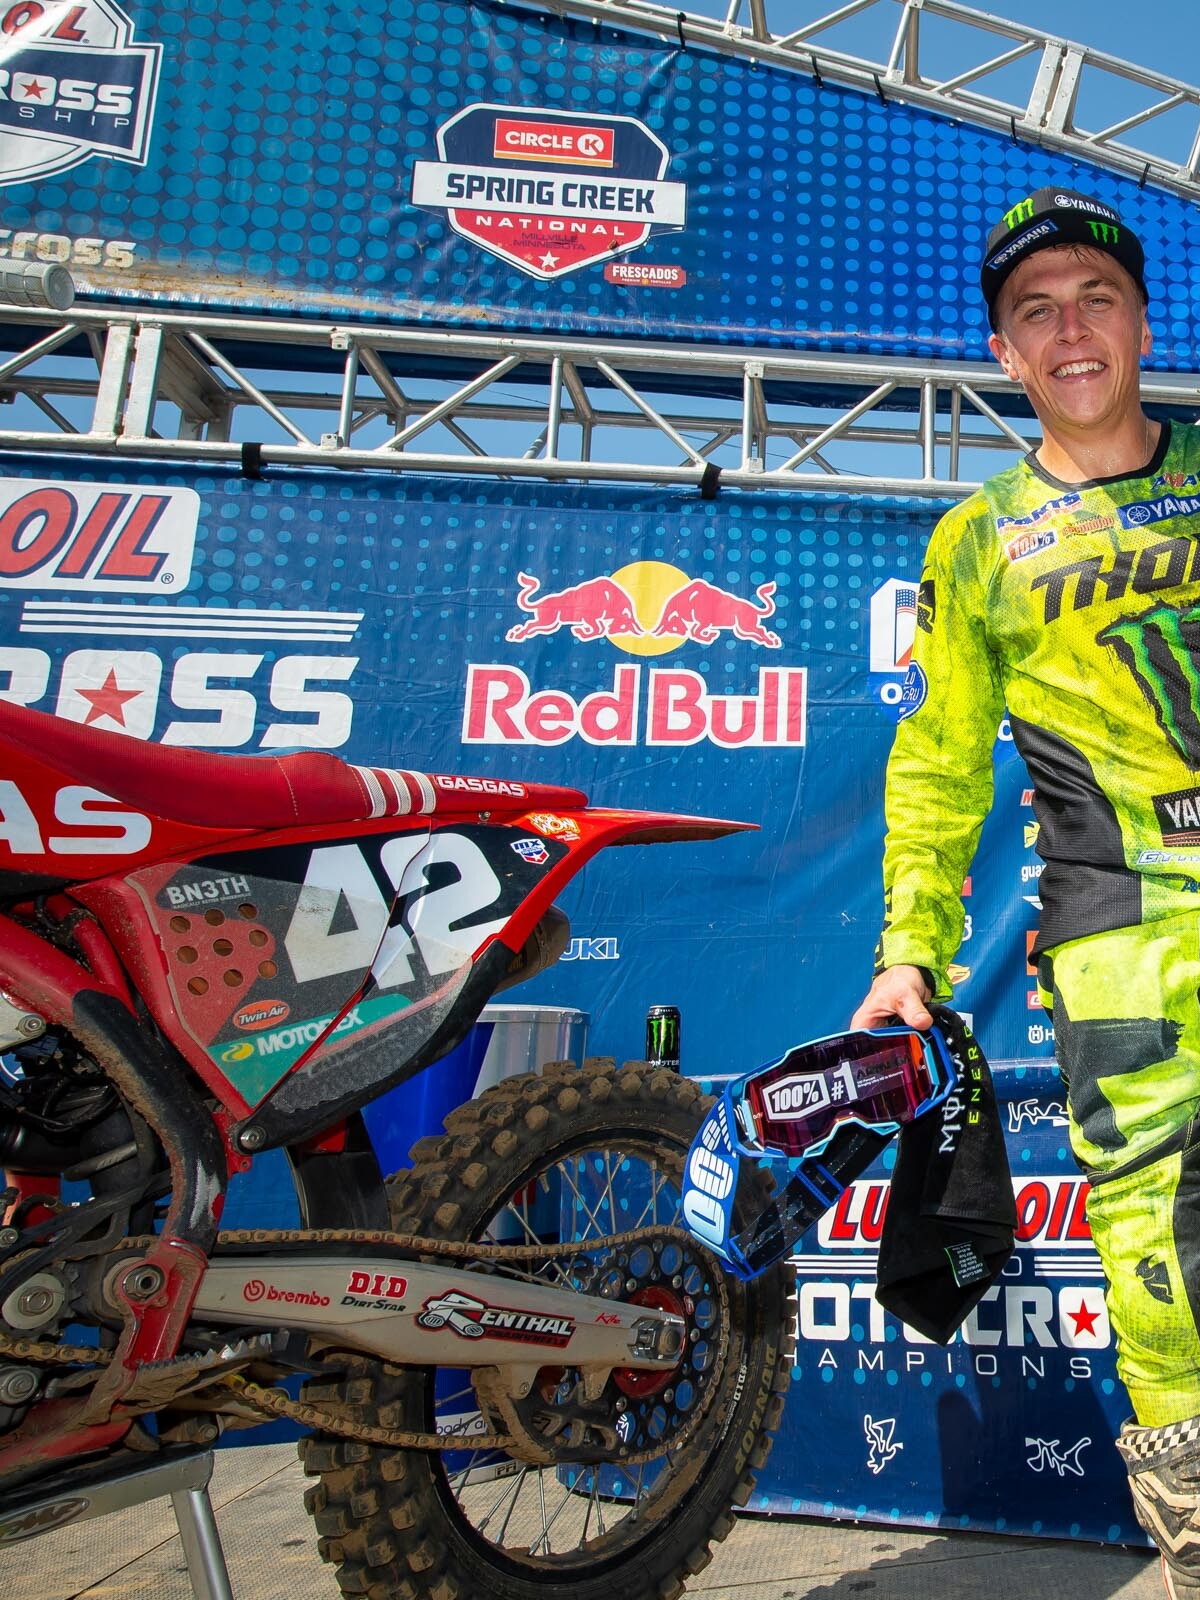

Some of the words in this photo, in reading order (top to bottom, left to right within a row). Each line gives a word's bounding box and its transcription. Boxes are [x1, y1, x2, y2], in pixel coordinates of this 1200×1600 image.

[1, 1, 88, 42] OL
[0, 69, 135, 115] OSS
[505, 130, 573, 150] CIRCLE
[578, 134, 604, 155] K
[446, 173, 555, 207] SPRING
[562, 182, 655, 214] CREEK
[1070, 198, 1116, 220] YAMAHA
[475, 215, 625, 237] NATIONAL
[521, 232, 578, 243] MILLVILLE
[513, 239, 586, 251] MINNESOTA
[612, 265, 679, 281] FRESCADOS
[1010, 530, 1054, 559] 100%
[461, 664, 642, 746] Red
[645, 667, 808, 748] Bull
[437, 776, 526, 797] GASGAS
[166, 875, 250, 905] BN3TH
[284, 832, 512, 990] 42
[239, 1012, 267, 1025] Twin
[268, 1005, 287, 1018] Air
[771, 1081, 820, 1113] 100%
[831, 1061, 858, 1101] #1
[267, 1284, 331, 1307] brembo
